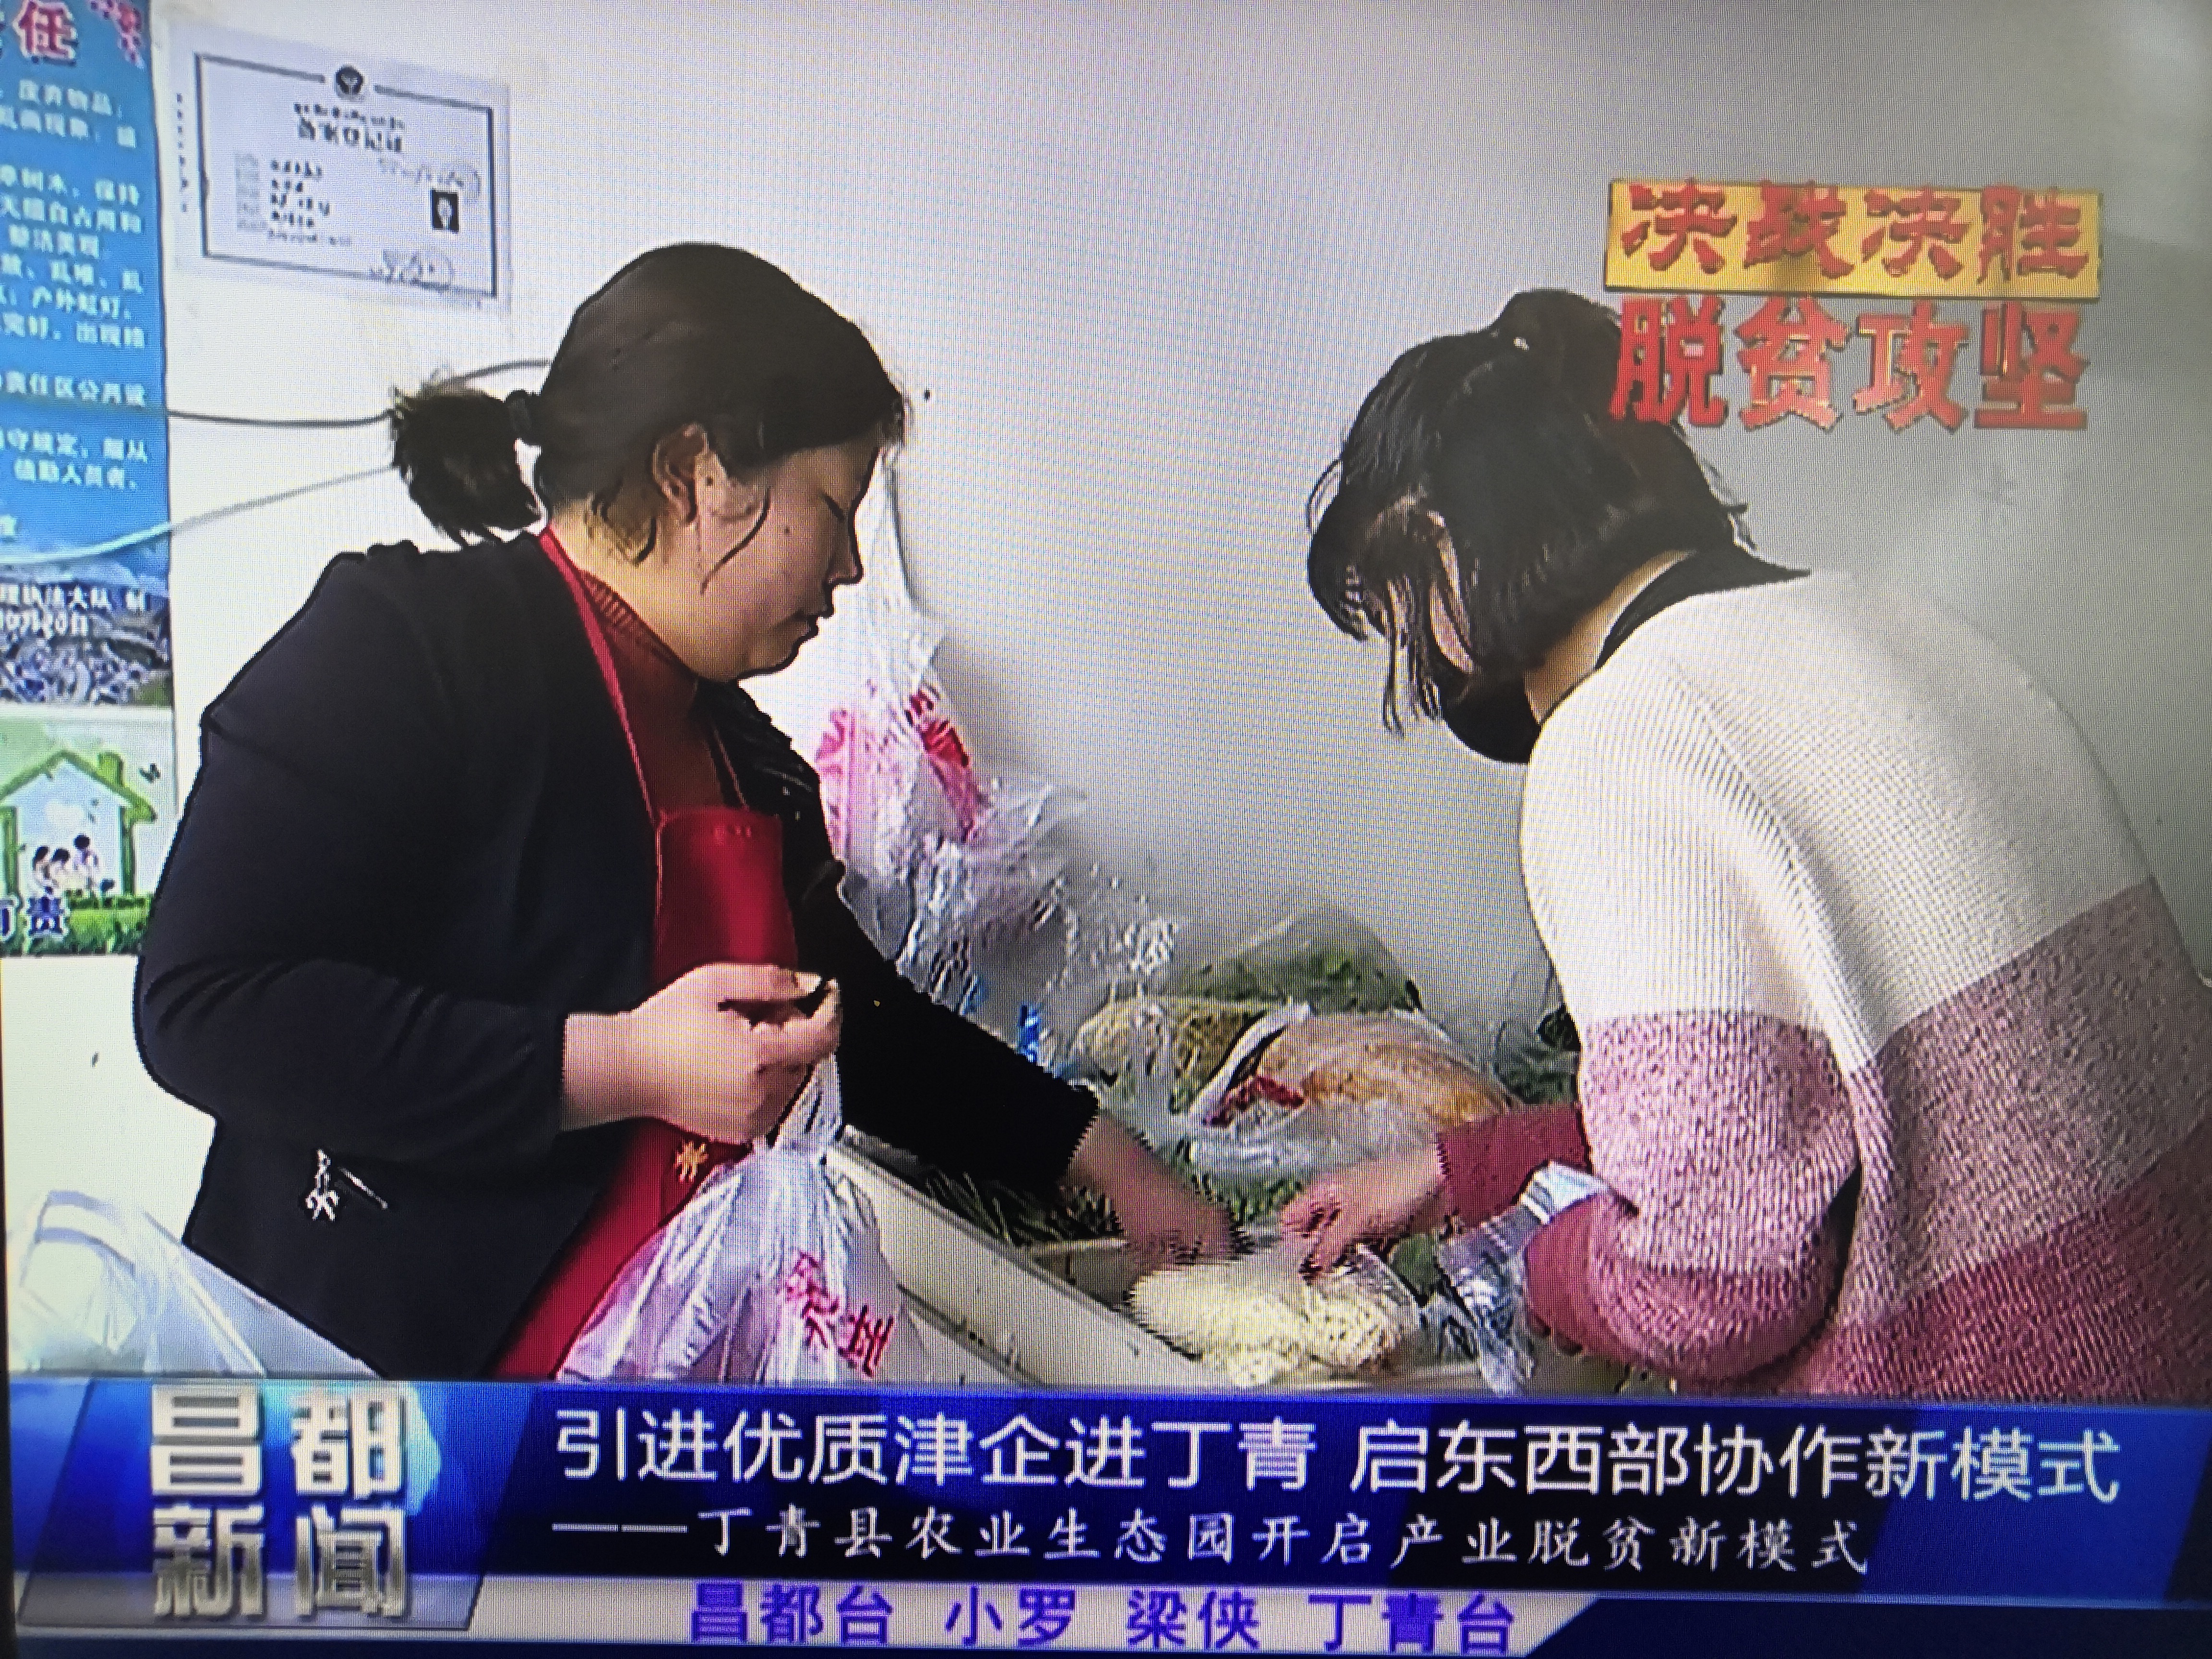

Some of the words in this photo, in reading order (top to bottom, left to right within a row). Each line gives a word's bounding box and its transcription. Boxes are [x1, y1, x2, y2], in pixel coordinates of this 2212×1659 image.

[1621, 180, 2089, 283] 决战决胜
[1609, 293, 2089, 432] 脱贫攻坚
[151, 1383, 404, 1501] 昌都
[555, 1408, 1317, 1492] 引进优质津企进丁青
[1349, 1418, 2122, 1504] 启东西部协作新模式
[153, 1503, 407, 1620] 新闻
[691, 1582, 895, 1647] 昌都台
[944, 1584, 1079, 1648] 小罗
[1127, 1588, 1261, 1651] 梁侠
[1307, 1593, 1517, 1656] 丁青台
